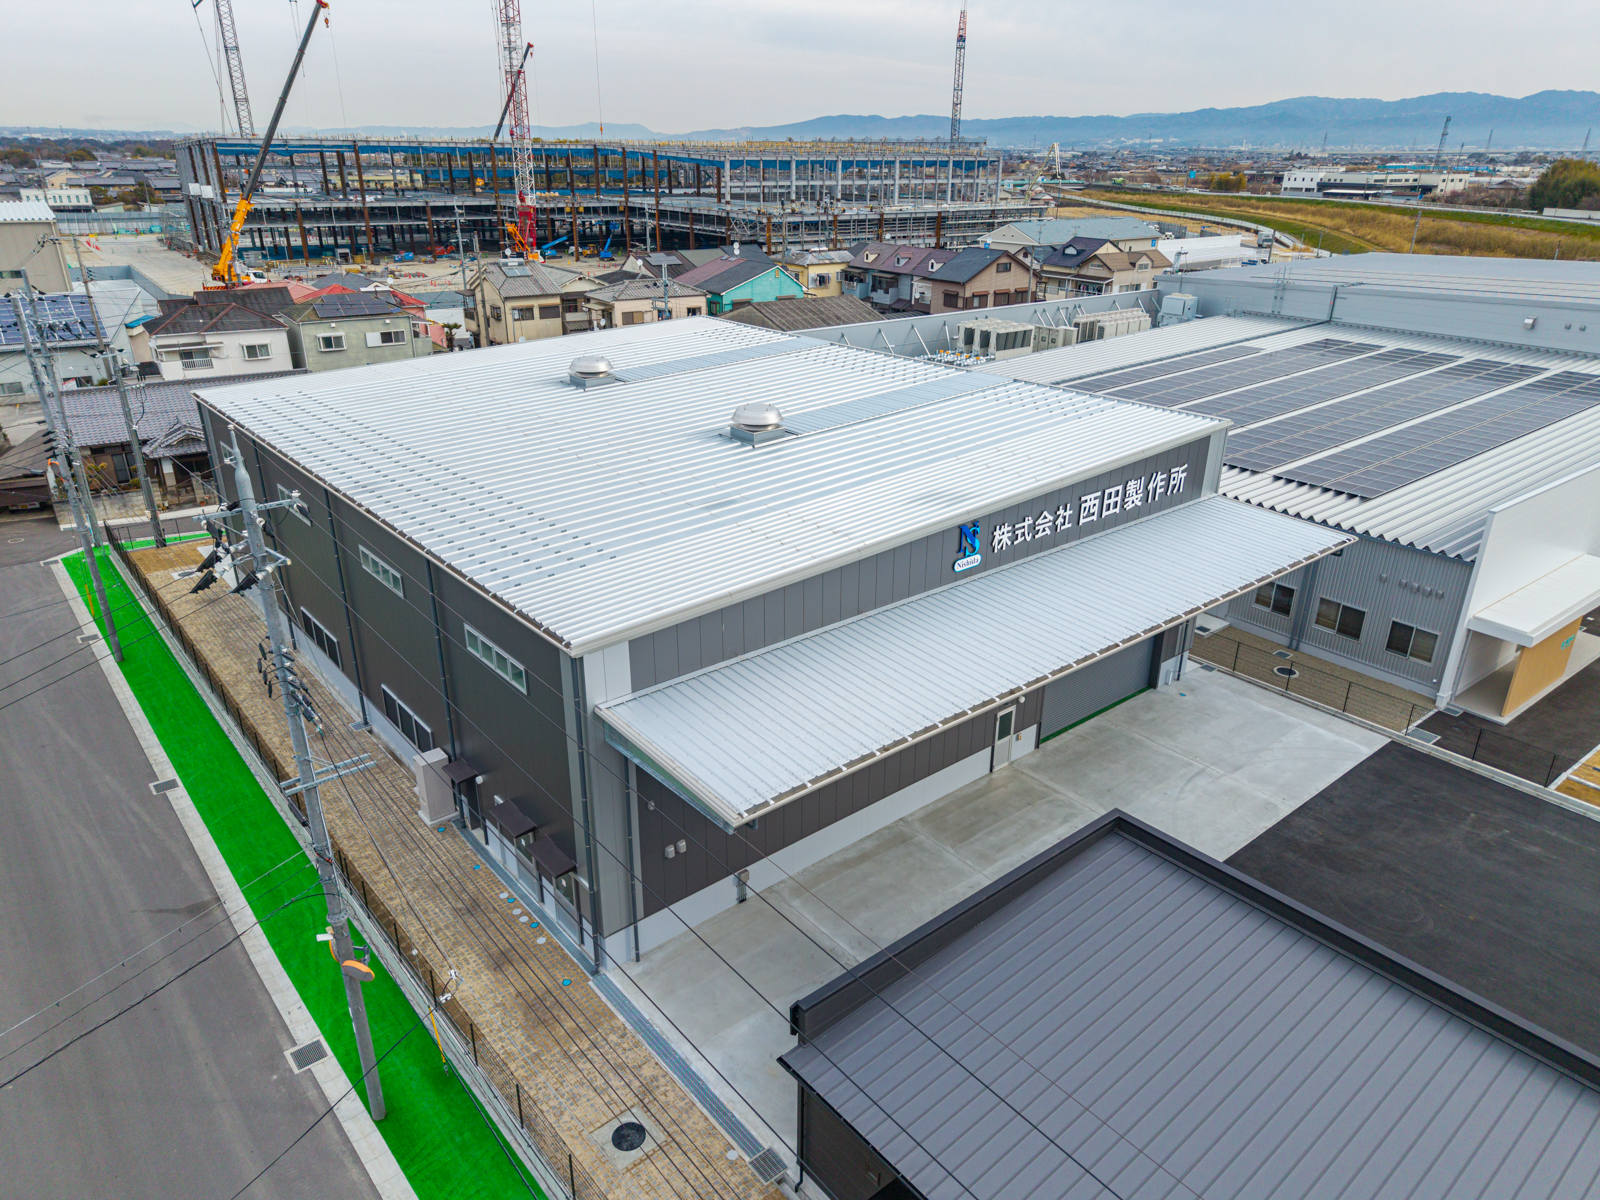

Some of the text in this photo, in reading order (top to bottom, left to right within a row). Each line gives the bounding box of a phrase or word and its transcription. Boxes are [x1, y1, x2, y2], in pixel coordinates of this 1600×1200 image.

[992, 503, 1073, 554] 株式会社
[956, 556, 980, 571] Nishida
